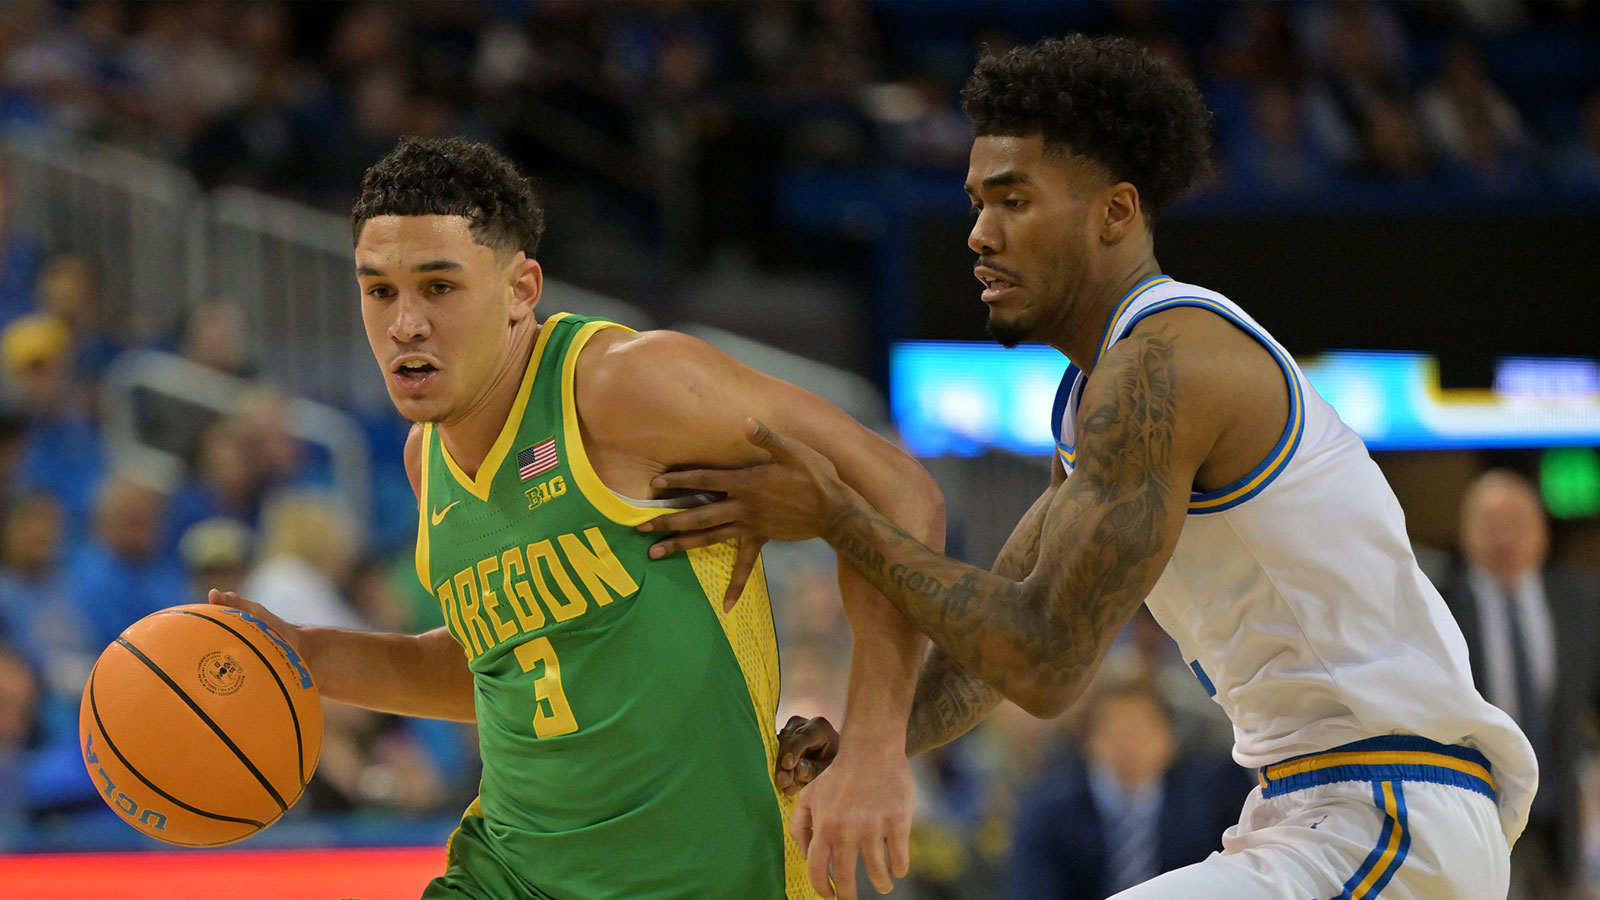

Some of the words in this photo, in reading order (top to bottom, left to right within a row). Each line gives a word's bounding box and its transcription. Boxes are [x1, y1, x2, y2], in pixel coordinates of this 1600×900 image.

[437, 526, 639, 662] OREGON
[888, 563, 943, 599] GOD
[513, 636, 579, 739] 3
[85, 732, 168, 831] UCLA
